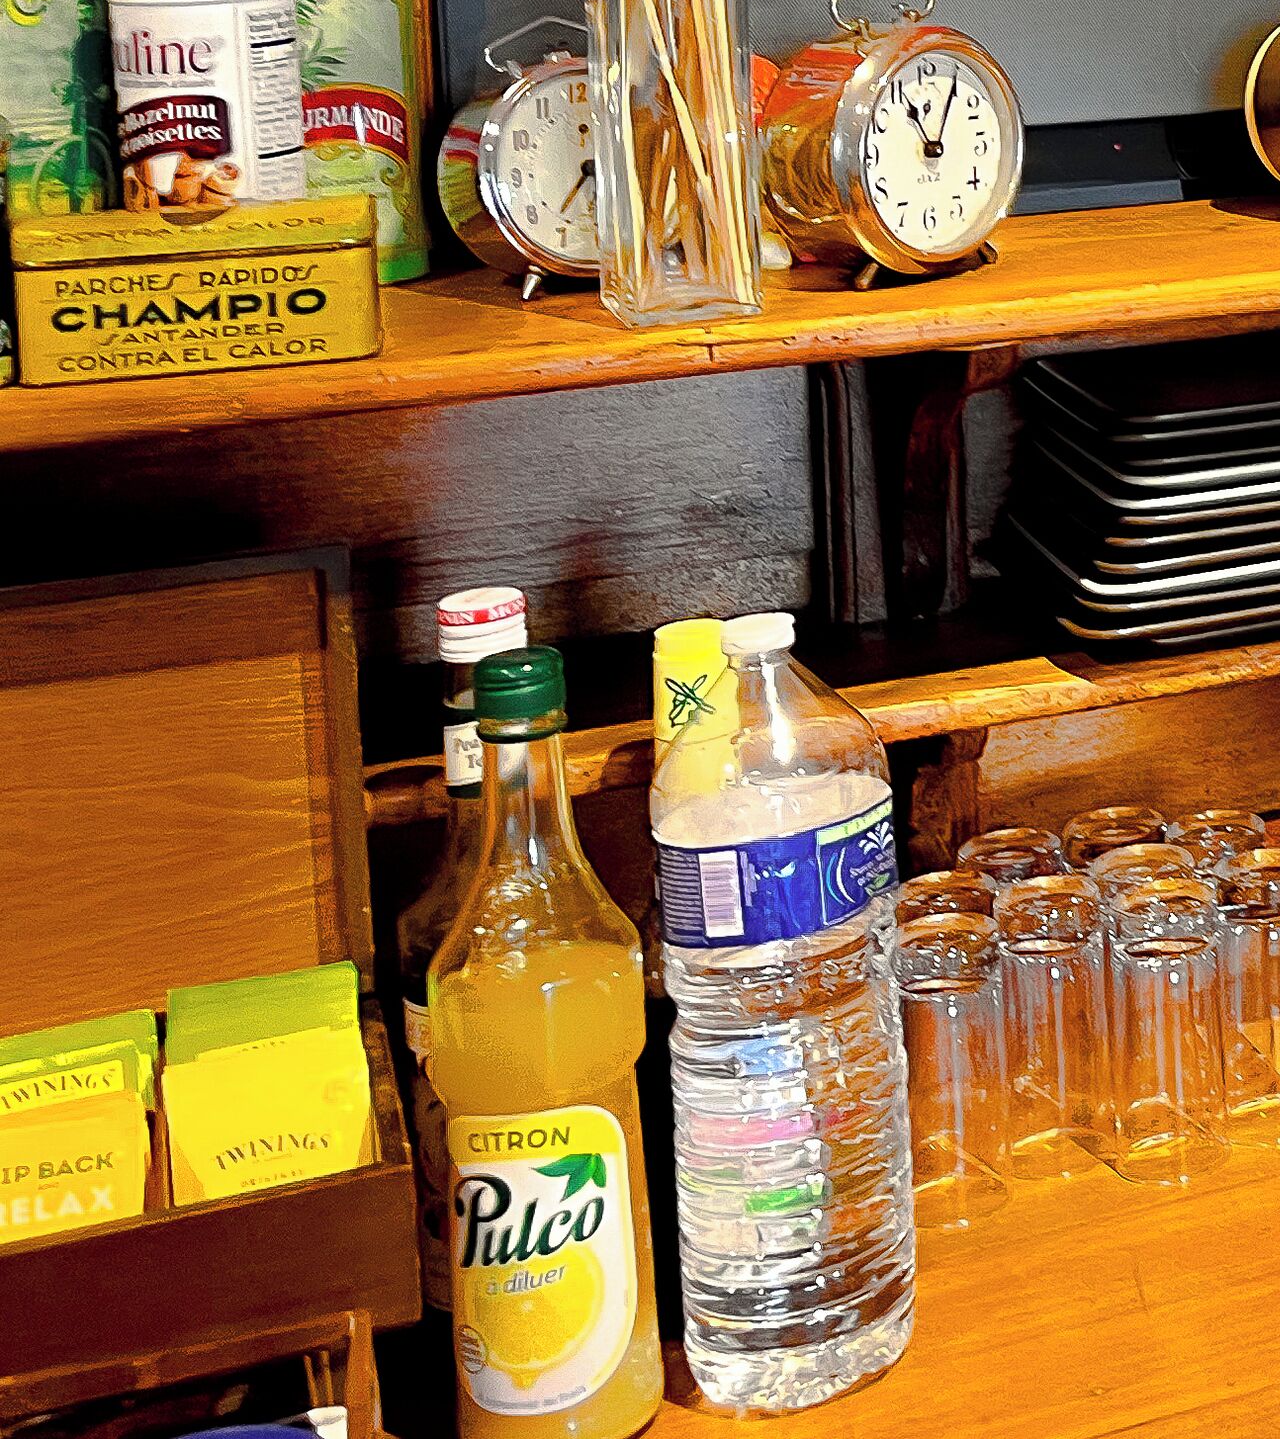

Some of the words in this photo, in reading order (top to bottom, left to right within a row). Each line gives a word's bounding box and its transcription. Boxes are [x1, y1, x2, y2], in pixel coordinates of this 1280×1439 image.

[535, 97, 550, 120] 11
[569, 82, 588, 105] 12
[922, 205, 937, 231] 6
[54, 272, 188, 297] PARCHES
[199, 264, 320, 288] RAPIDOS
[50, 287, 327, 333] CHAMPIO
[100, 322, 286, 346] SANTANDER
[57, 350, 177, 373] CONTRA
[182, 347, 211, 363] EL
[228, 338, 329, 361] CALOR
[215, 1133, 331, 1171] TWININGS
[467, 1126, 571, 1154] CITRON
[37, 1151, 115, 1181] BACK
[455, 1172, 606, 1269] Pulco
[504, 1264, 566, 1295] diluer
